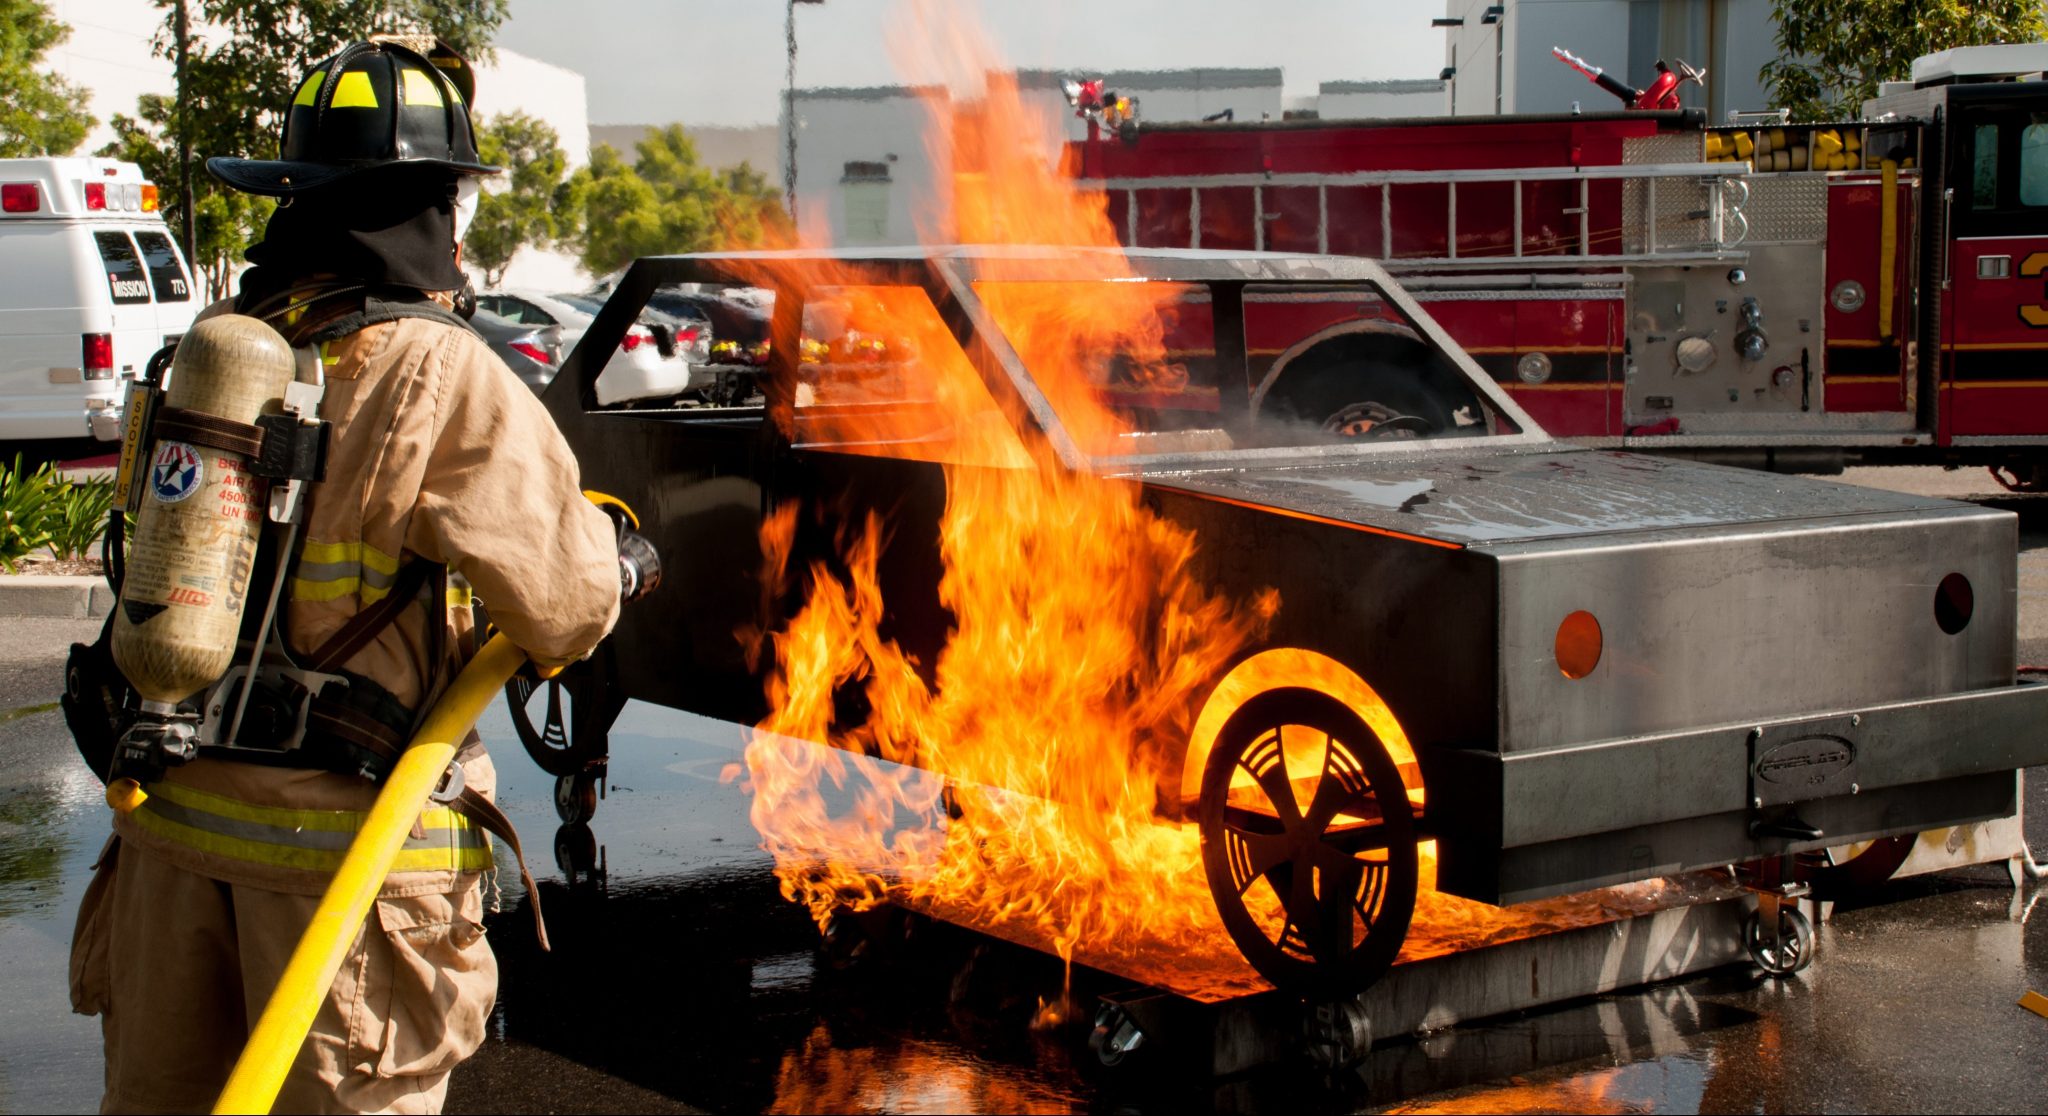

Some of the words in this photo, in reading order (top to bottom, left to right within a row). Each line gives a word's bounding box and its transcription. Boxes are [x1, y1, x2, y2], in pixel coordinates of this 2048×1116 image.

[113, 280, 148, 298] MISSION
[170, 279, 187, 295] 773
[125, 401, 142, 469] SCOTT
[222, 474, 245, 488] AIR
[218, 489, 246, 504] 4500
[222, 504, 240, 518] UN
[224, 525, 257, 616] SCOTT
[167, 587, 214, 608] SCOTT
